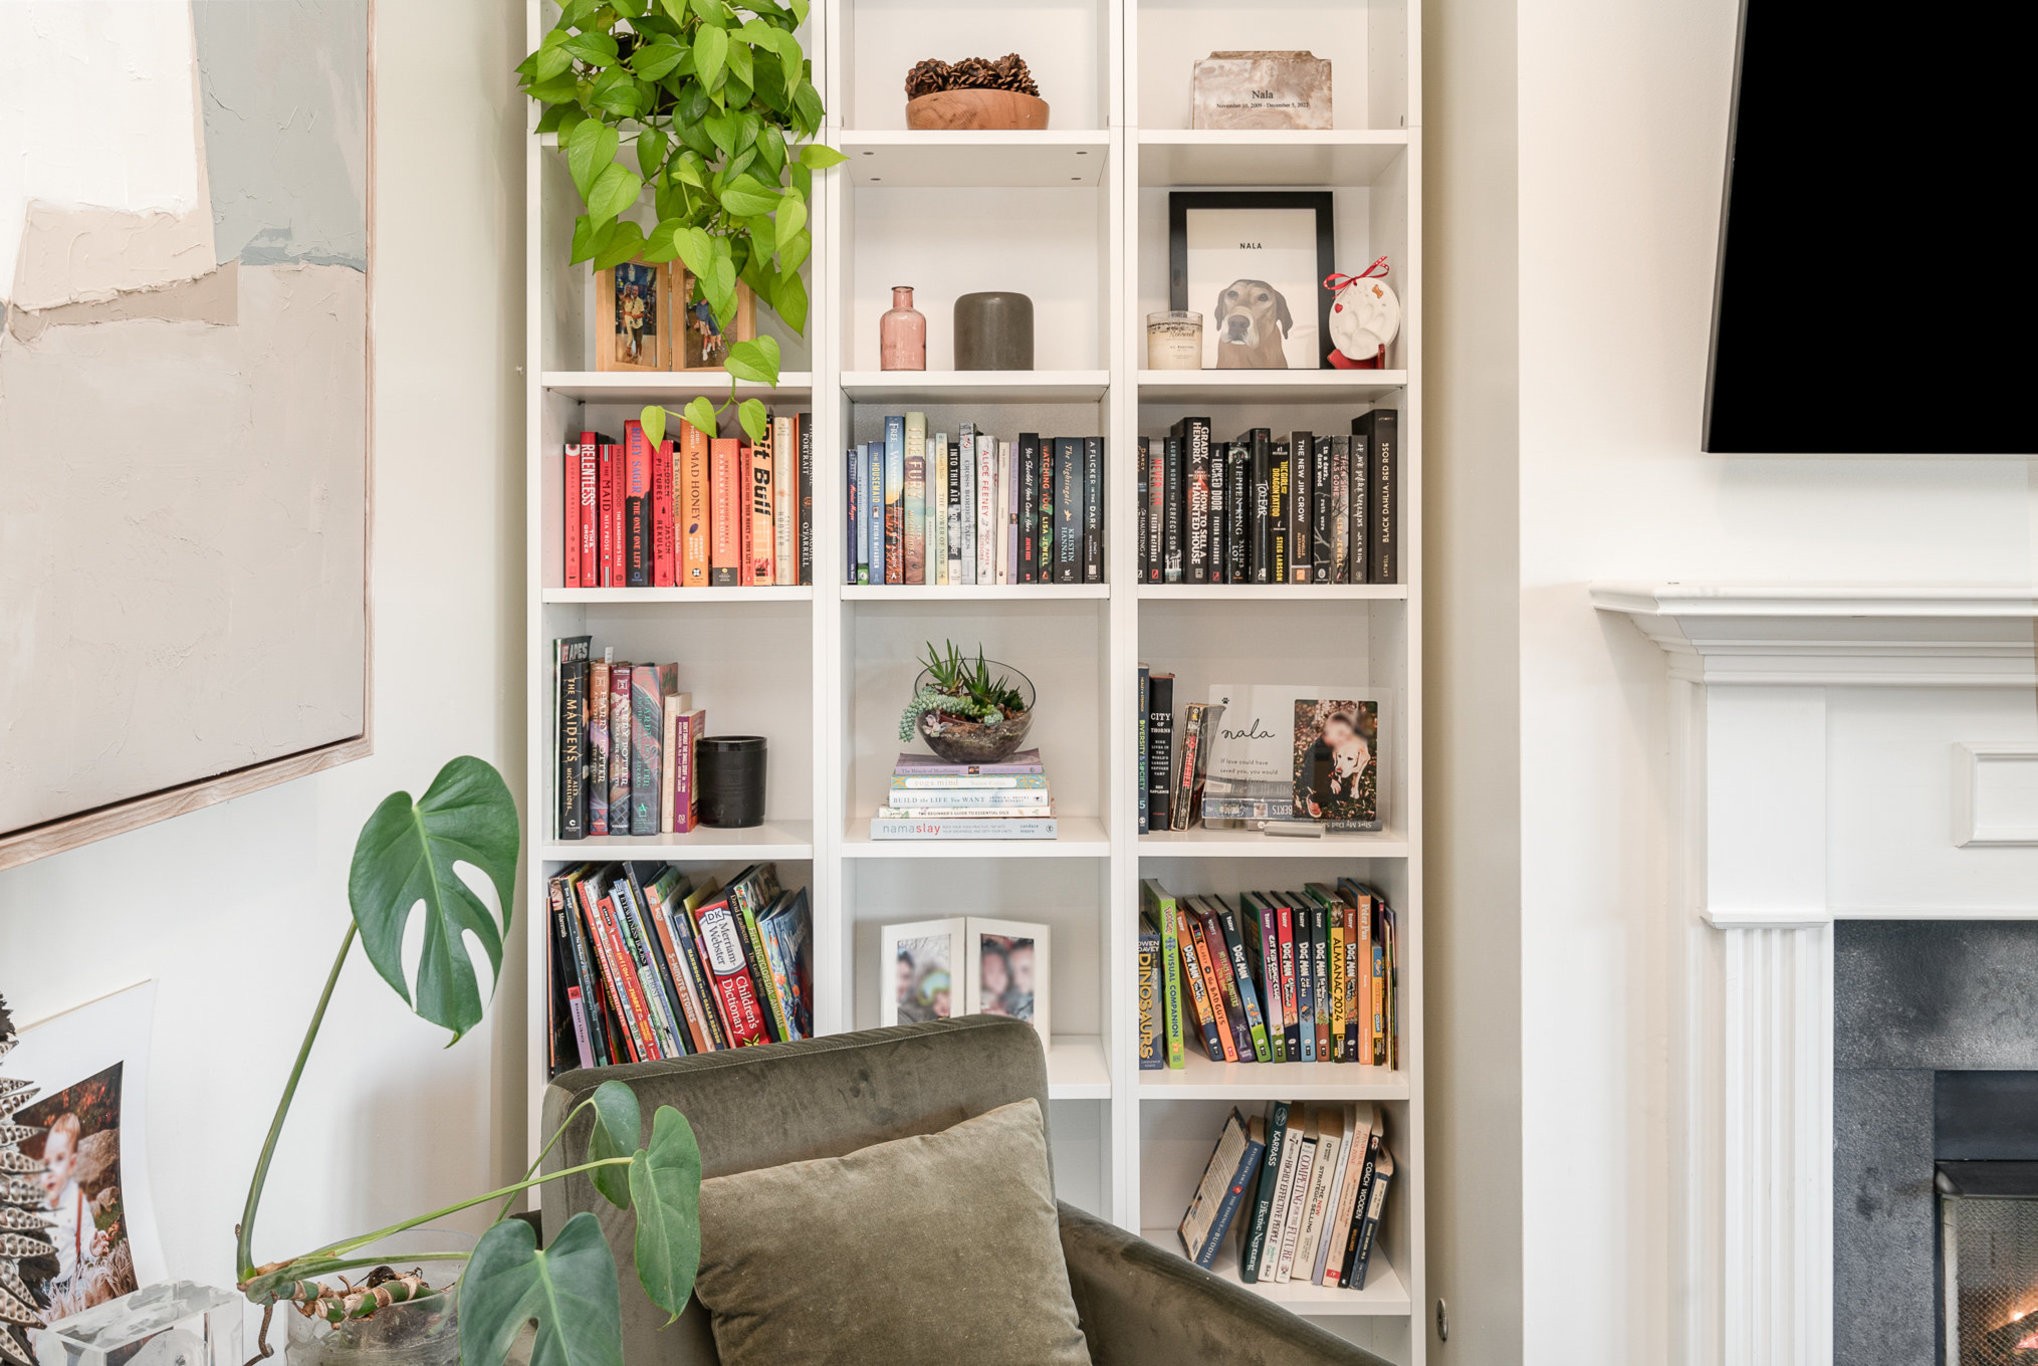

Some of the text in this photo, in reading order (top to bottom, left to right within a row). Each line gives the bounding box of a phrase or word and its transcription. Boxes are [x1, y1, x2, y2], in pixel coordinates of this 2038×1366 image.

[1252, 90, 1274, 99] Nala
[631, 427, 641, 493] RILEY SAGER
[1192, 422, 1201, 464] HENDRIX
[1200, 427, 1209, 459] GRADY
[581, 444, 596, 506] RELENTLESS
[690, 451, 700, 520] MAD HONEY
[754, 468, 770, 516] Bull
[872, 462, 880, 503] HOUSEMAID
[950, 448, 958, 502] INTO THIN AIR
[981, 450, 990, 517] ALICE FEENEY
[1042, 446, 1050, 510] WATCHING YOU
[1062, 445, 1073, 506] The Nightingale
[1211, 458, 1222, 511] LOCKED DOOR
[1272, 468, 1280, 517] DRAGON TATTOO
[1235, 459, 1243, 535] STEPHEN KING
[1191, 482, 1200, 564] HAUNTED HOUSE
[1200, 515, 1207, 526] TO
[1200, 550, 1207, 558] A
[567, 678, 577, 762] THE MAIDENS
[598, 690, 606, 783] HARRY POTTER
[620, 692, 628, 786] HARRY POTTER
[1221, 718, 1276, 740] nala
[1139, 800, 1146, 809] 5
[883, 822, 940, 835] namaslay
[557, 912, 568, 938] Mammals
[619, 895, 648, 965] EYEWITNESS BOOKS
[707, 910, 723, 921] DK
[1360, 903, 1368, 924] Peter
[706, 925, 728, 965] Webster
[716, 920, 740, 966] Merriam-
[1182, 944, 1200, 979] DOG MAN
[1231, 943, 1249, 979] DOG MAN
[1281, 941, 1292, 976] DOG MAN
[1298, 941, 1309, 976] DOG MAN
[1315, 942, 1325, 959] DOG
[1346, 942, 1356, 959] DOG
[667, 952, 696, 1023] 5-MINUTE STORIES
[1316, 960, 1325, 977] MAN
[1333, 937, 1343, 1022] ALMANAC 2024
[1346, 960, 1356, 977] MAN
[717, 977, 749, 1037] Dictionary
[732, 974, 761, 1029] Children's
[1139, 953, 1153, 1059] DINOSAURS
[1170, 984, 1179, 1038] COMPANION
[1209, 986, 1218, 1003] BAD
[1214, 1003, 1225, 1025] GUYS
[1267, 1129, 1281, 1167] KARRASS
[1269, 1137, 1298, 1244] 7 HIGHLY EFFECTIVE PEOPLE
[1312, 1165, 1324, 1201] STRATEGIC
[1354, 1160, 1373, 1219] COACH WOODEN
[1255, 1200, 1268, 1230] Effective
[1280, 1153, 1311, 1262] COMPETING FUTURE
[1305, 1203, 1316, 1233] SELLING
[1201, 1230, 1220, 1264] BUDDHA
